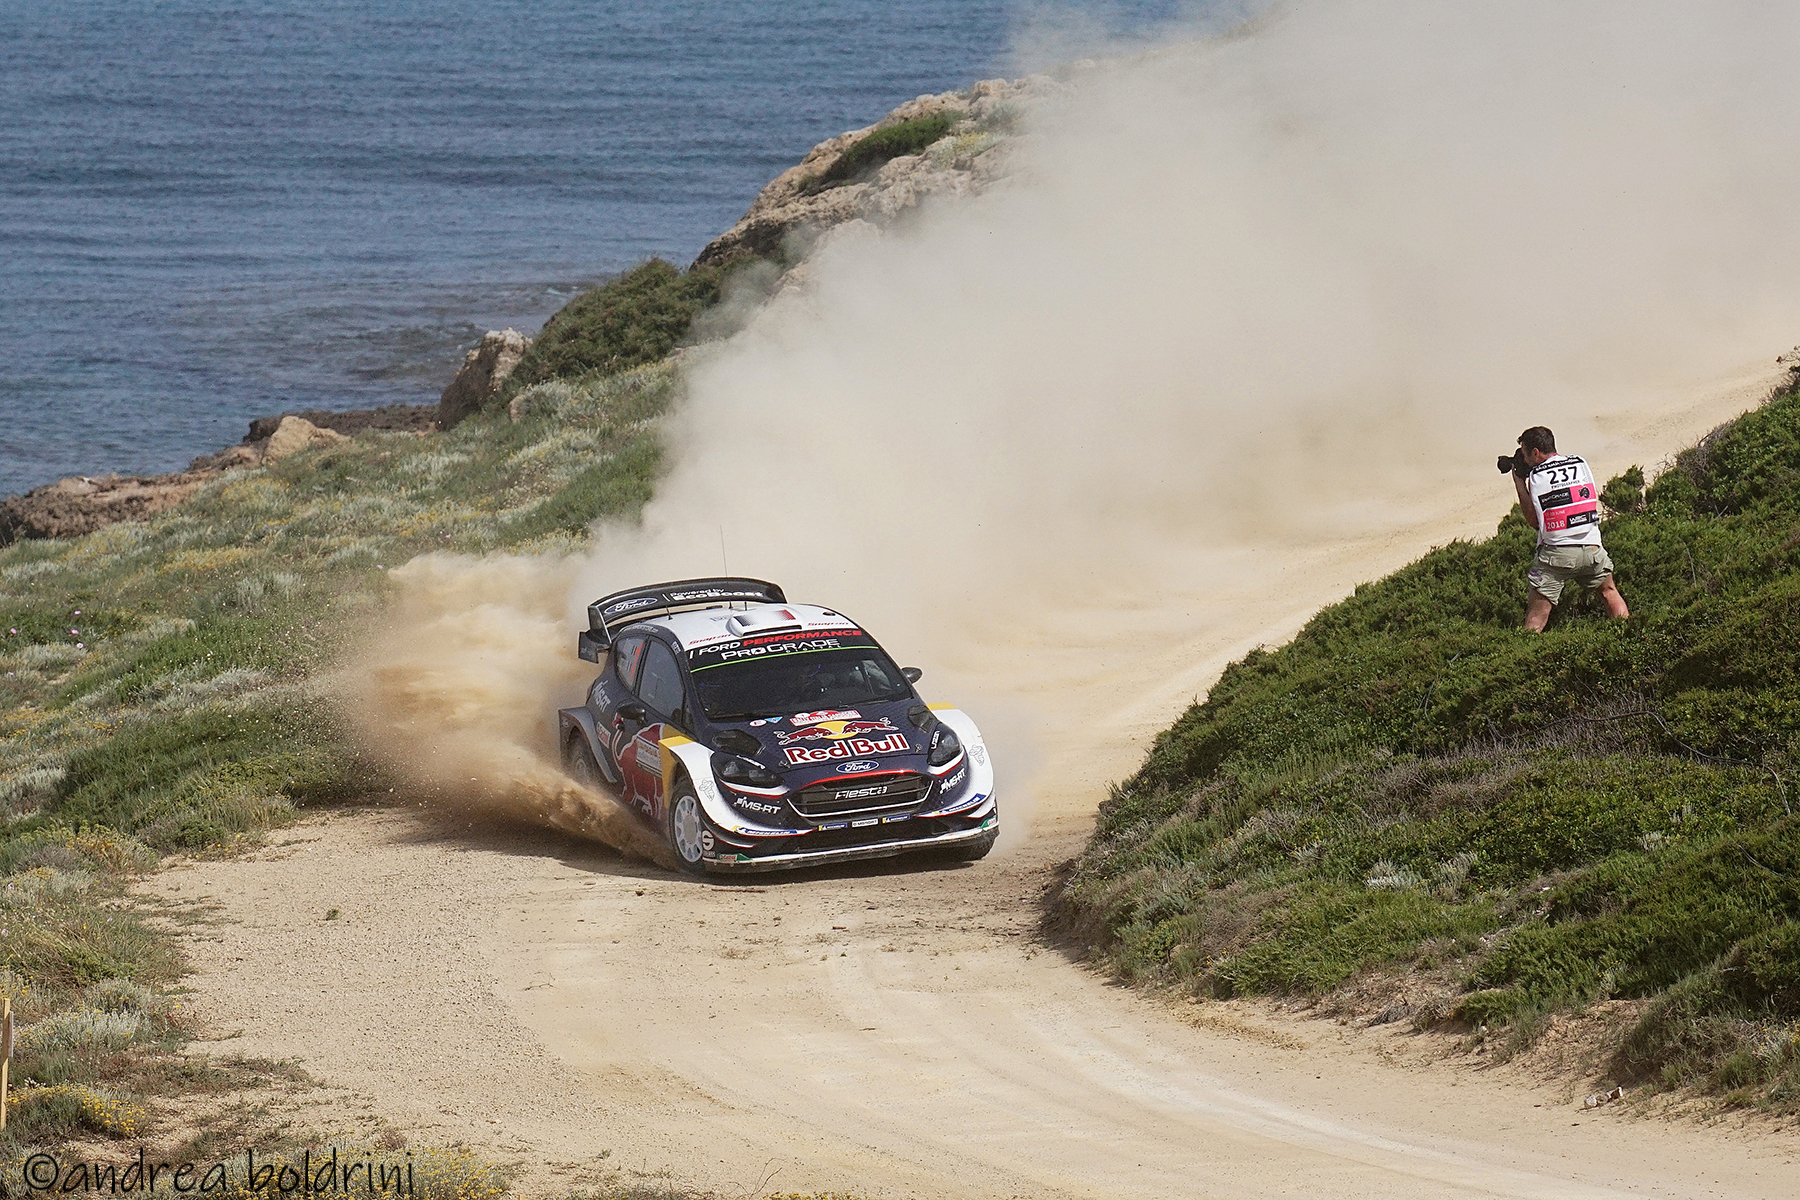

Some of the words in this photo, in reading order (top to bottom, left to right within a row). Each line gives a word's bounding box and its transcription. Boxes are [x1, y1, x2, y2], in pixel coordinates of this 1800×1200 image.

[1546, 466, 1577, 485] 237
[1547, 520, 1566, 529] 2018
[670, 589, 711, 597] Powered
[672, 591, 764, 600] EcoBoost
[614, 599, 650, 612] Ford
[699, 641, 741, 656] FORD
[742, 629, 863, 647] PERFORMANCE
[721, 638, 840, 661] PROGRADE
[785, 740, 850, 764] Red
[850, 734, 909, 755] Bull
[843, 762, 872, 772] Ford
[835, 786, 888, 800] Fiesta
[741, 800, 781, 814] MS-RT
